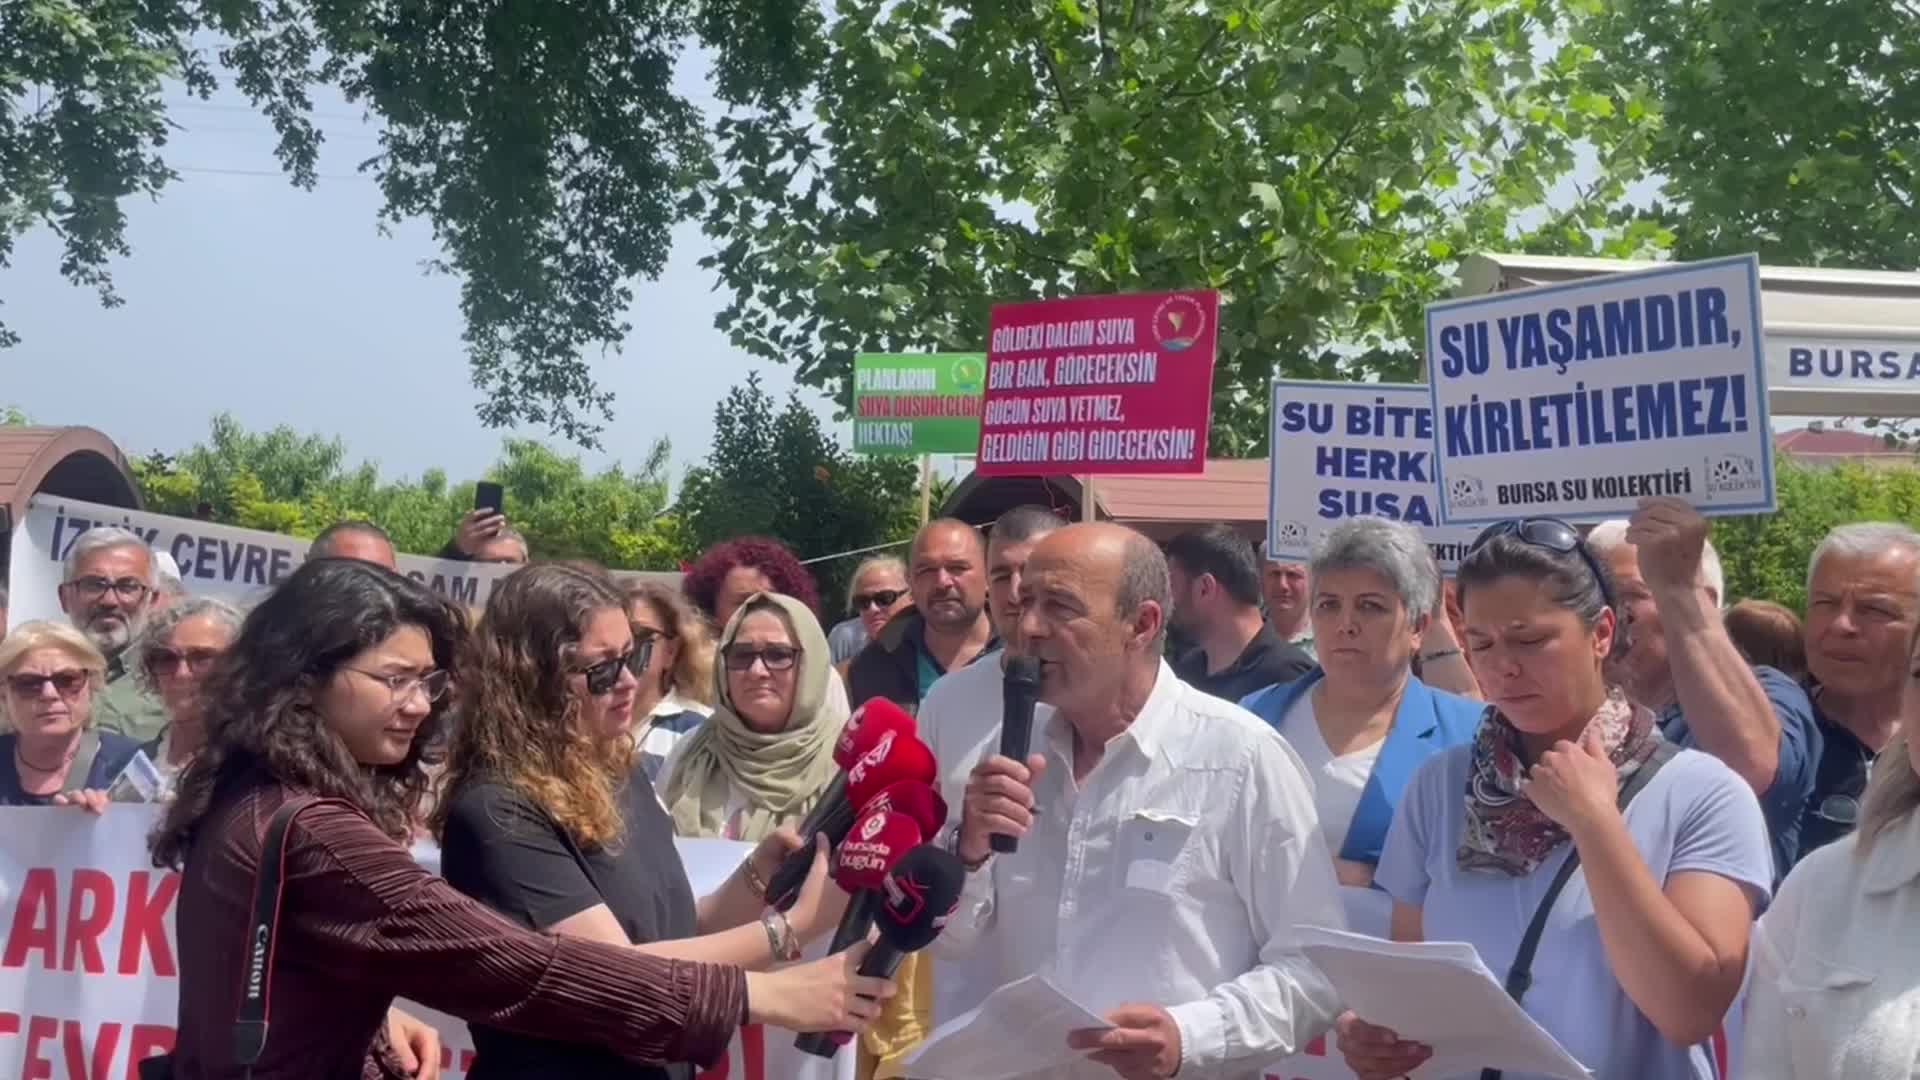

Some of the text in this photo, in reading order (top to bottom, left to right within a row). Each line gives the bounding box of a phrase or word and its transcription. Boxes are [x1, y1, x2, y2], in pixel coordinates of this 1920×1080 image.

[992, 318, 1135, 353] GÖLDEKİ DALGIN SUYA
[1440, 286, 1742, 378] SU YAŞAMDIR,
[989, 359, 1012, 390] BİR
[1016, 356, 1050, 389] BAK,
[1054, 350, 1158, 386] GÖRECEKSİN
[1789, 347, 1920, 380] BURSA
[984, 394, 1125, 426] GÜCÜN SUYA YETMEZ,
[1281, 401, 1334, 435] SU
[1444, 373, 1749, 458] KİRLETİLEMEZ!
[1052, 427, 1085, 461] GİBİ
[1088, 426, 1196, 461] GİDECEKSİN!
[1497, 480, 1559, 505] BURSA
[1563, 479, 1587, 502] SU
[1591, 467, 1692, 500] KOLEKTİFİ
[1318, 488, 1440, 527] SUSA
[247, 923, 268, 998] Canon
